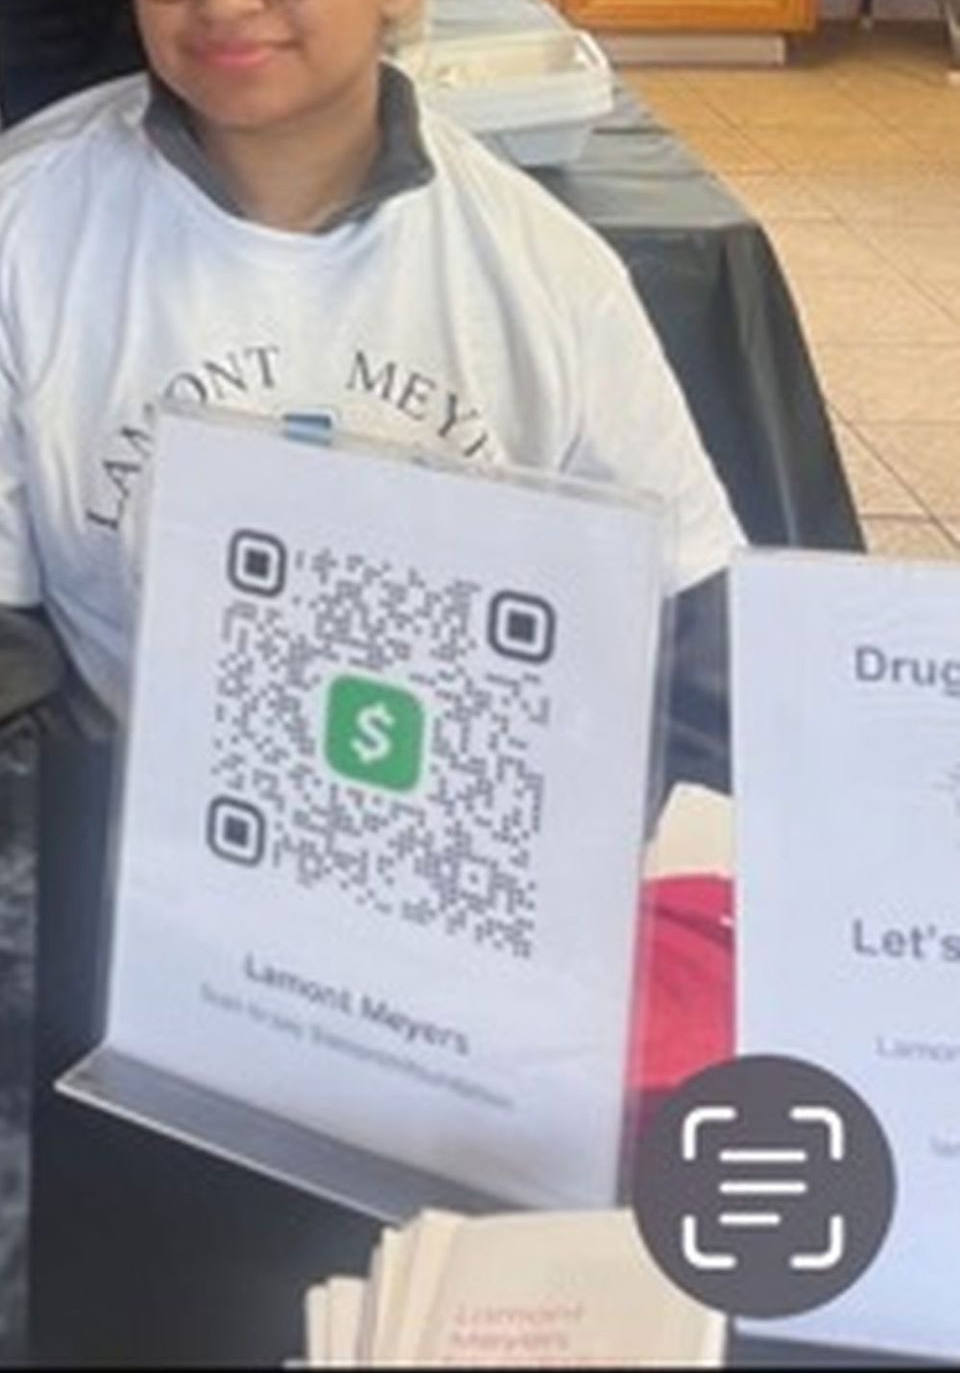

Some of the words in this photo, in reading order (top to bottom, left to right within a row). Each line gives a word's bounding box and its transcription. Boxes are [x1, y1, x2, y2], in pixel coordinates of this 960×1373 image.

[852, 918, 960, 963] Let's
[244, 951, 352, 1015] Lamont
[359, 993, 470, 1057] Meyers
